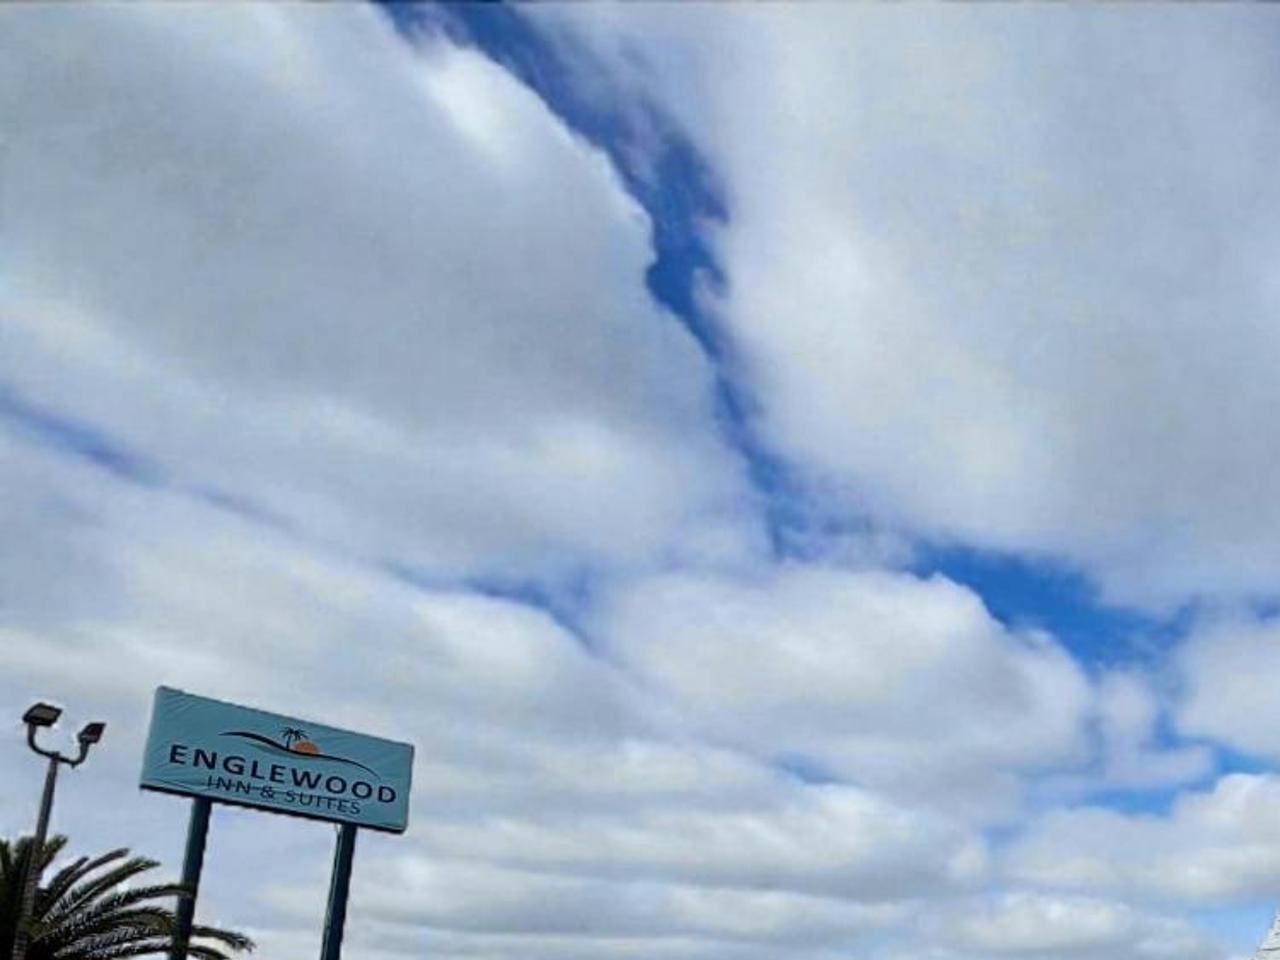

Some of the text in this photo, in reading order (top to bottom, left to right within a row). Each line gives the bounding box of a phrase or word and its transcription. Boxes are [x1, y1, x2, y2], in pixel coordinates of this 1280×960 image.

[169, 744, 397, 803] ENGLEWOOD
[207, 774, 362, 816] INN & SUITES
